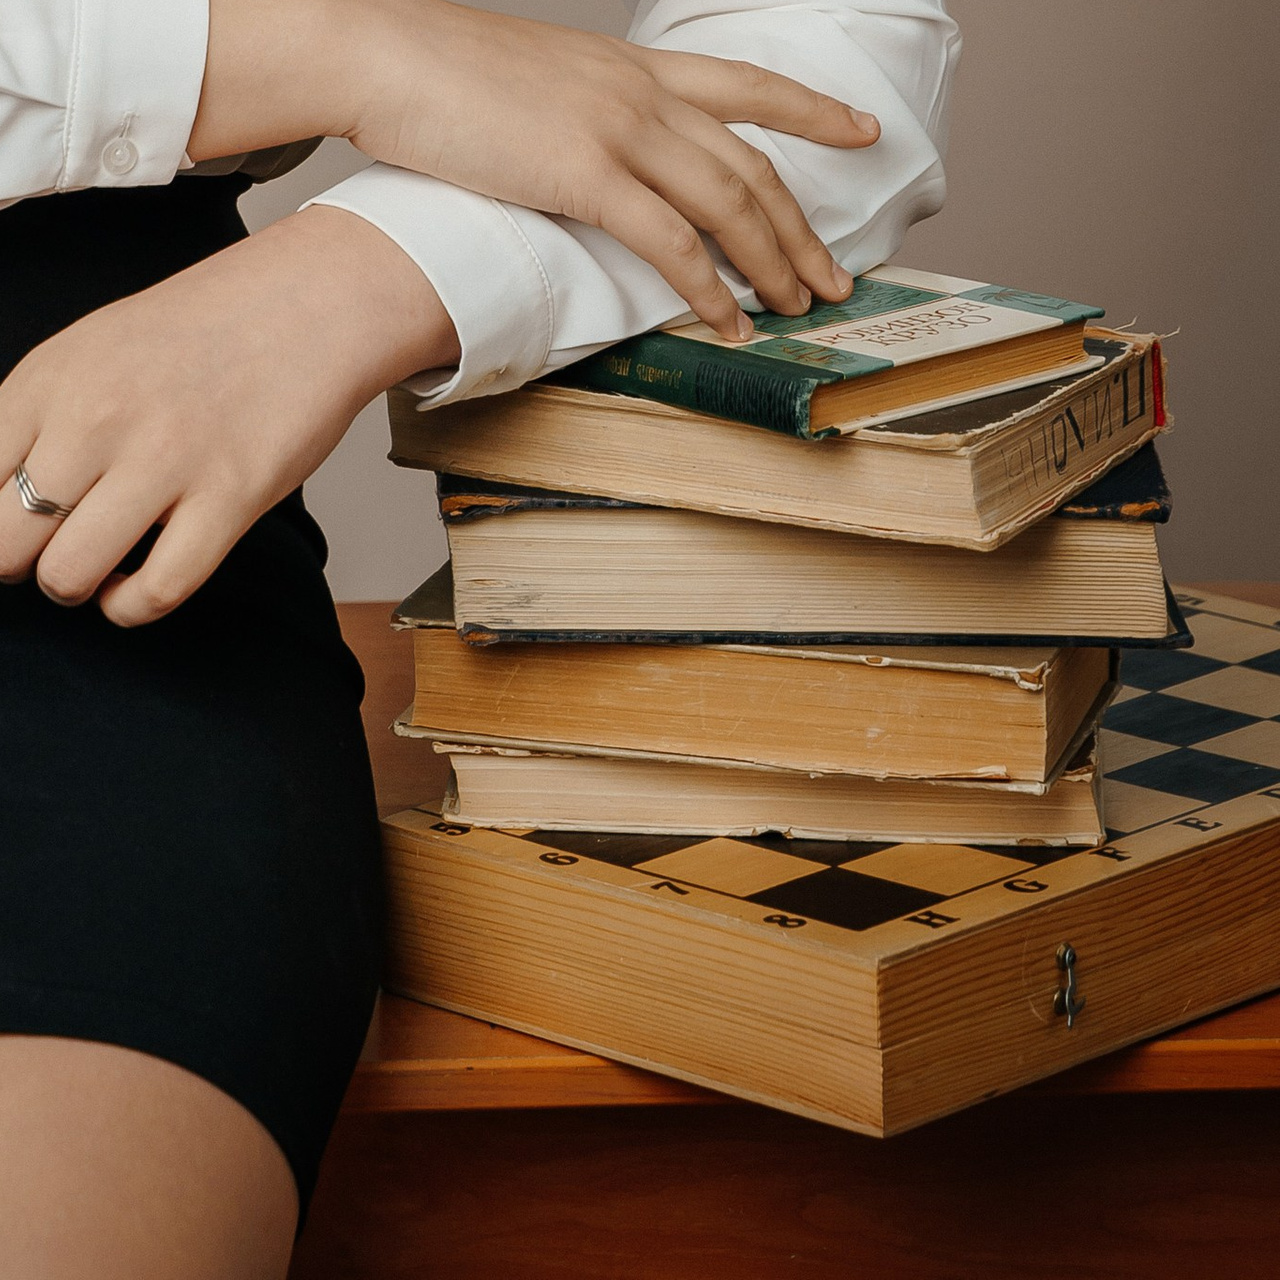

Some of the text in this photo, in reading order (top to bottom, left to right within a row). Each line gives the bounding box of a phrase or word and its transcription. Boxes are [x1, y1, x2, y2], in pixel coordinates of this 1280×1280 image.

[816, 302, 991, 346] РОБИНЗОН
[862, 313, 993, 348] КРУЗО
[903, 817, 1224, 929] H G F E
[650, 881, 690, 896] 7
[763, 913, 807, 929] 8
